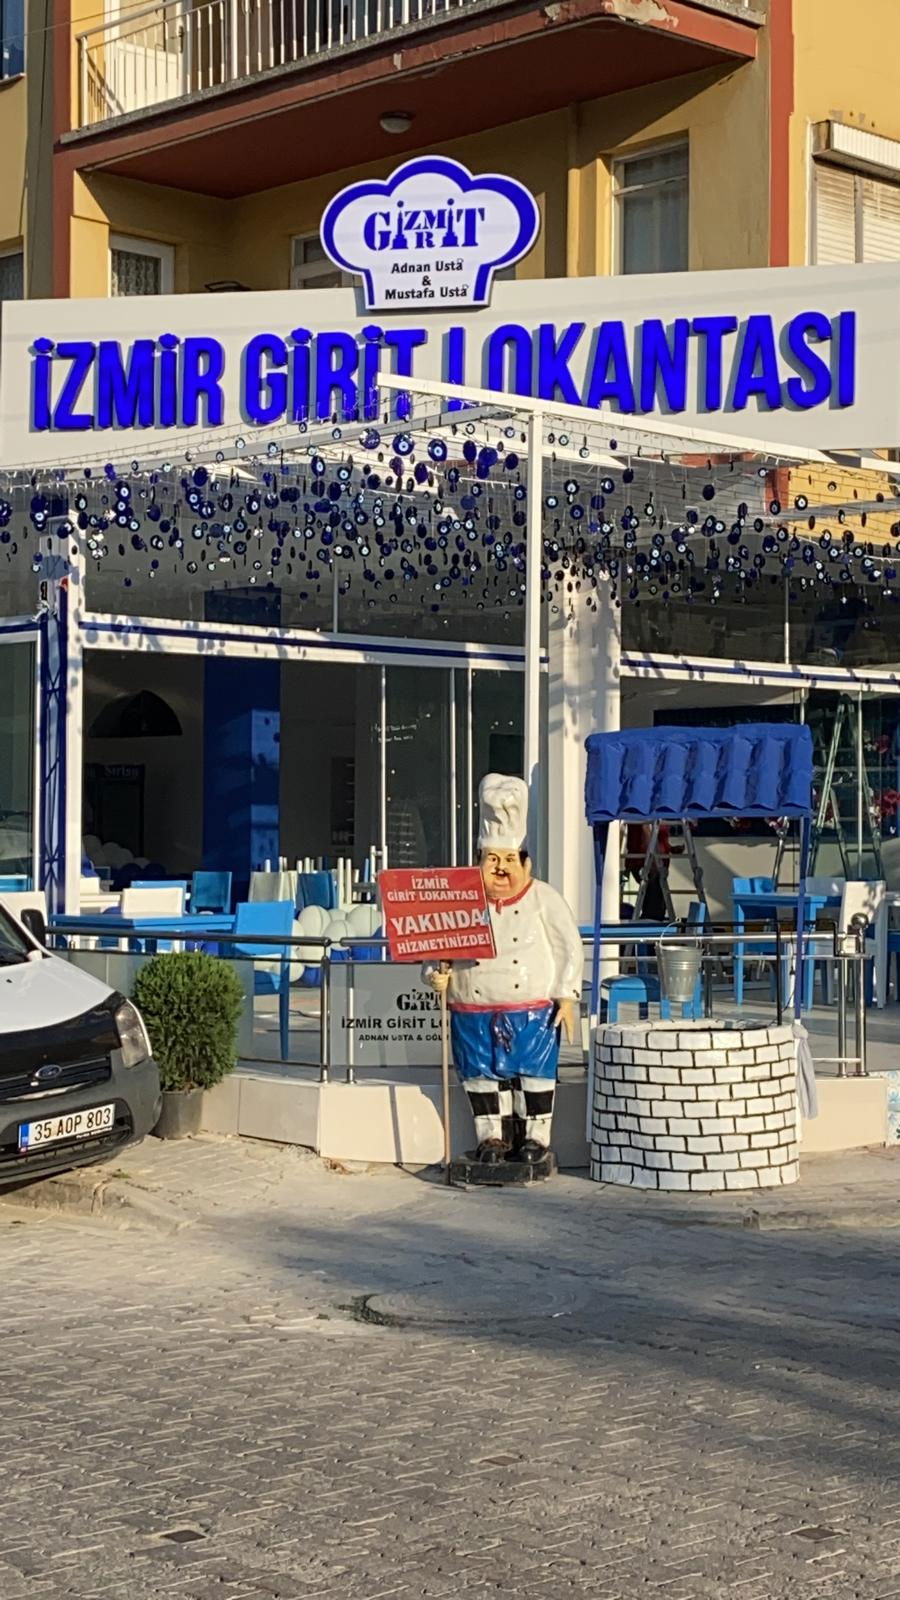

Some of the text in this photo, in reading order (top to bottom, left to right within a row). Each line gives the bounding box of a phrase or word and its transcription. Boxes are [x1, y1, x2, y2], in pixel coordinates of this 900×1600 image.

[391, 262, 430, 274] Adnan
[422, 275, 431, 286] &
[385, 288, 434, 300] Mustafa
[32, 311, 856, 430] İZMİR GİRİT LOKANTASI
[411, 875, 449, 890] İZMİR
[387, 889, 479, 902] GİRİT LOKANTASI
[390, 908, 487, 936] YAKINDA
[396, 932, 491, 955] HİZMETİNİZDE!
[341, 1015, 382, 1029] İZMİR
[386, 1015, 426, 1029] GİRİT
[34, 1121, 52, 1142] 35
[56, 1115, 82, 1136] AOP
[86, 1108, 111, 1129] 803
